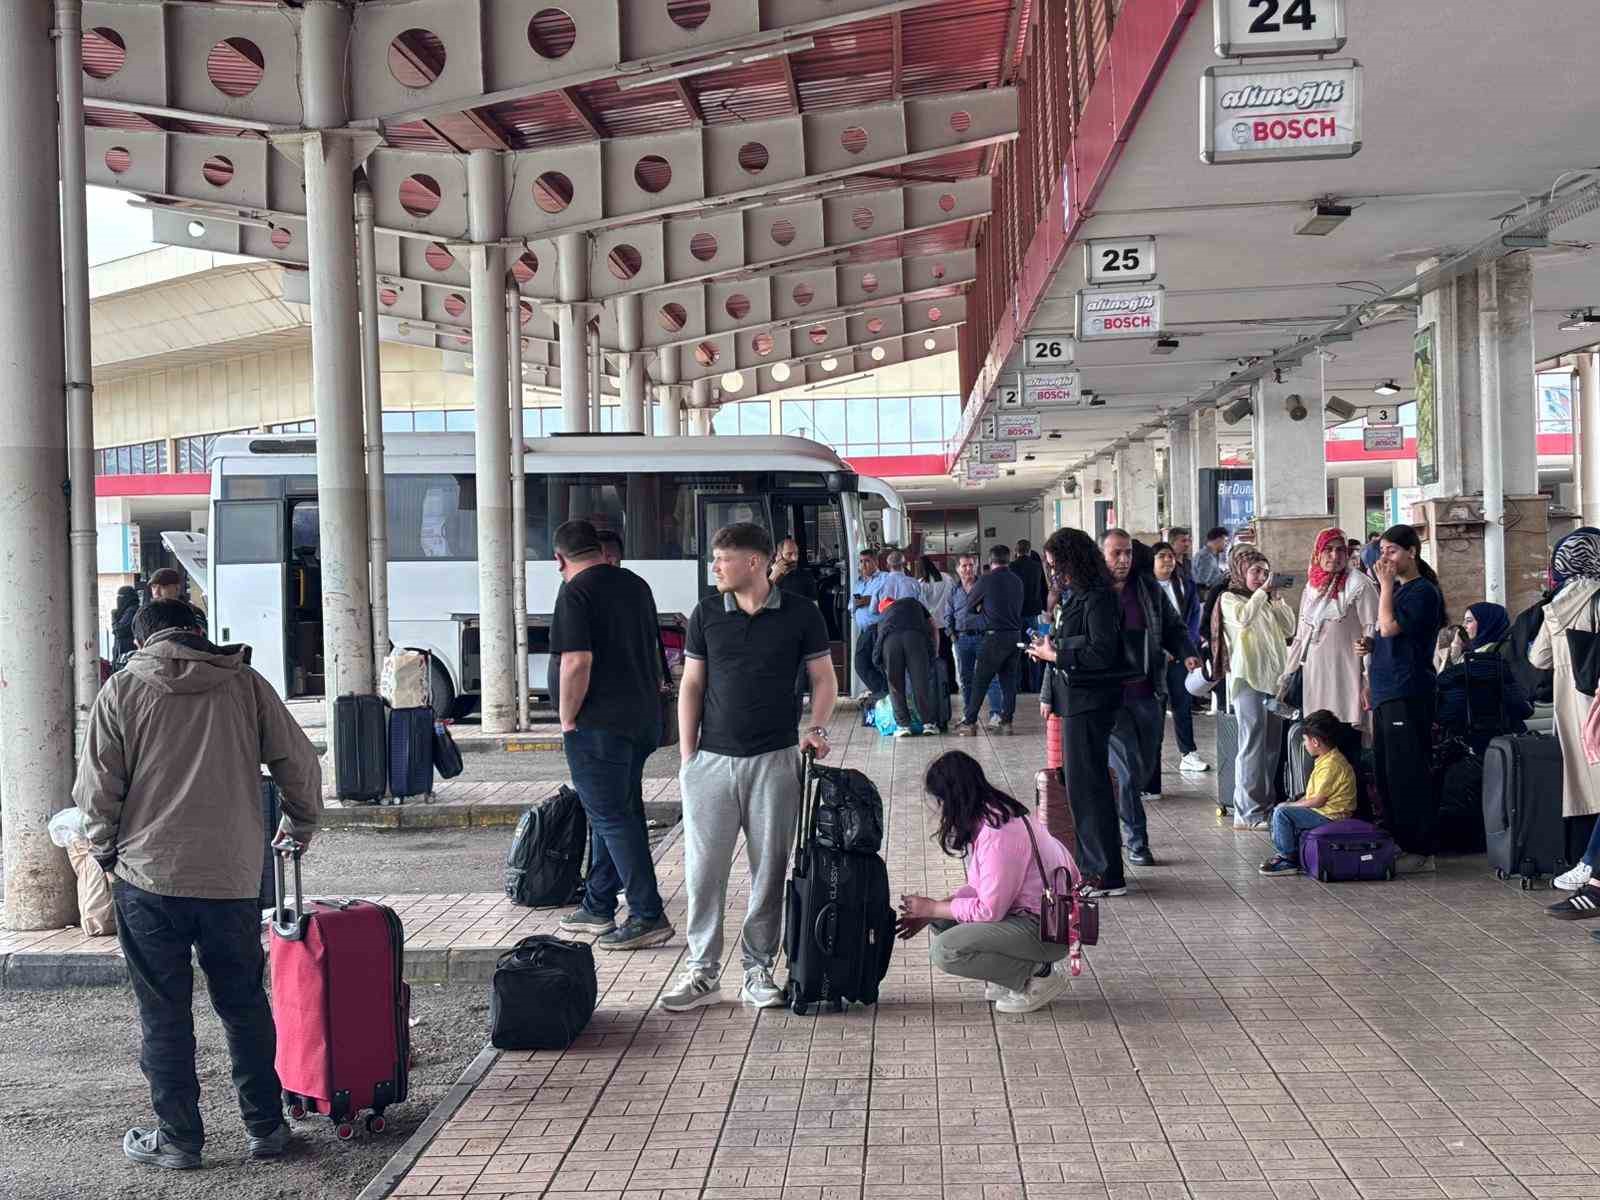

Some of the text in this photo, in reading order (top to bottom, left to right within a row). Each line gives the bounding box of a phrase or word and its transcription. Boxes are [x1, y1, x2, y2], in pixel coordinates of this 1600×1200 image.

[1248, 0, 1316, 33] 24
[1253, 117, 1336, 141] BOSCH
[1102, 248, 1139, 272] 25
[1104, 316, 1150, 329] BOSCH
[1035, 342, 1062, 358] 26
[1006, 391, 1018, 403] 2
[1038, 390, 1070, 400] BOSCH
[1379, 409, 1388, 420] 3
